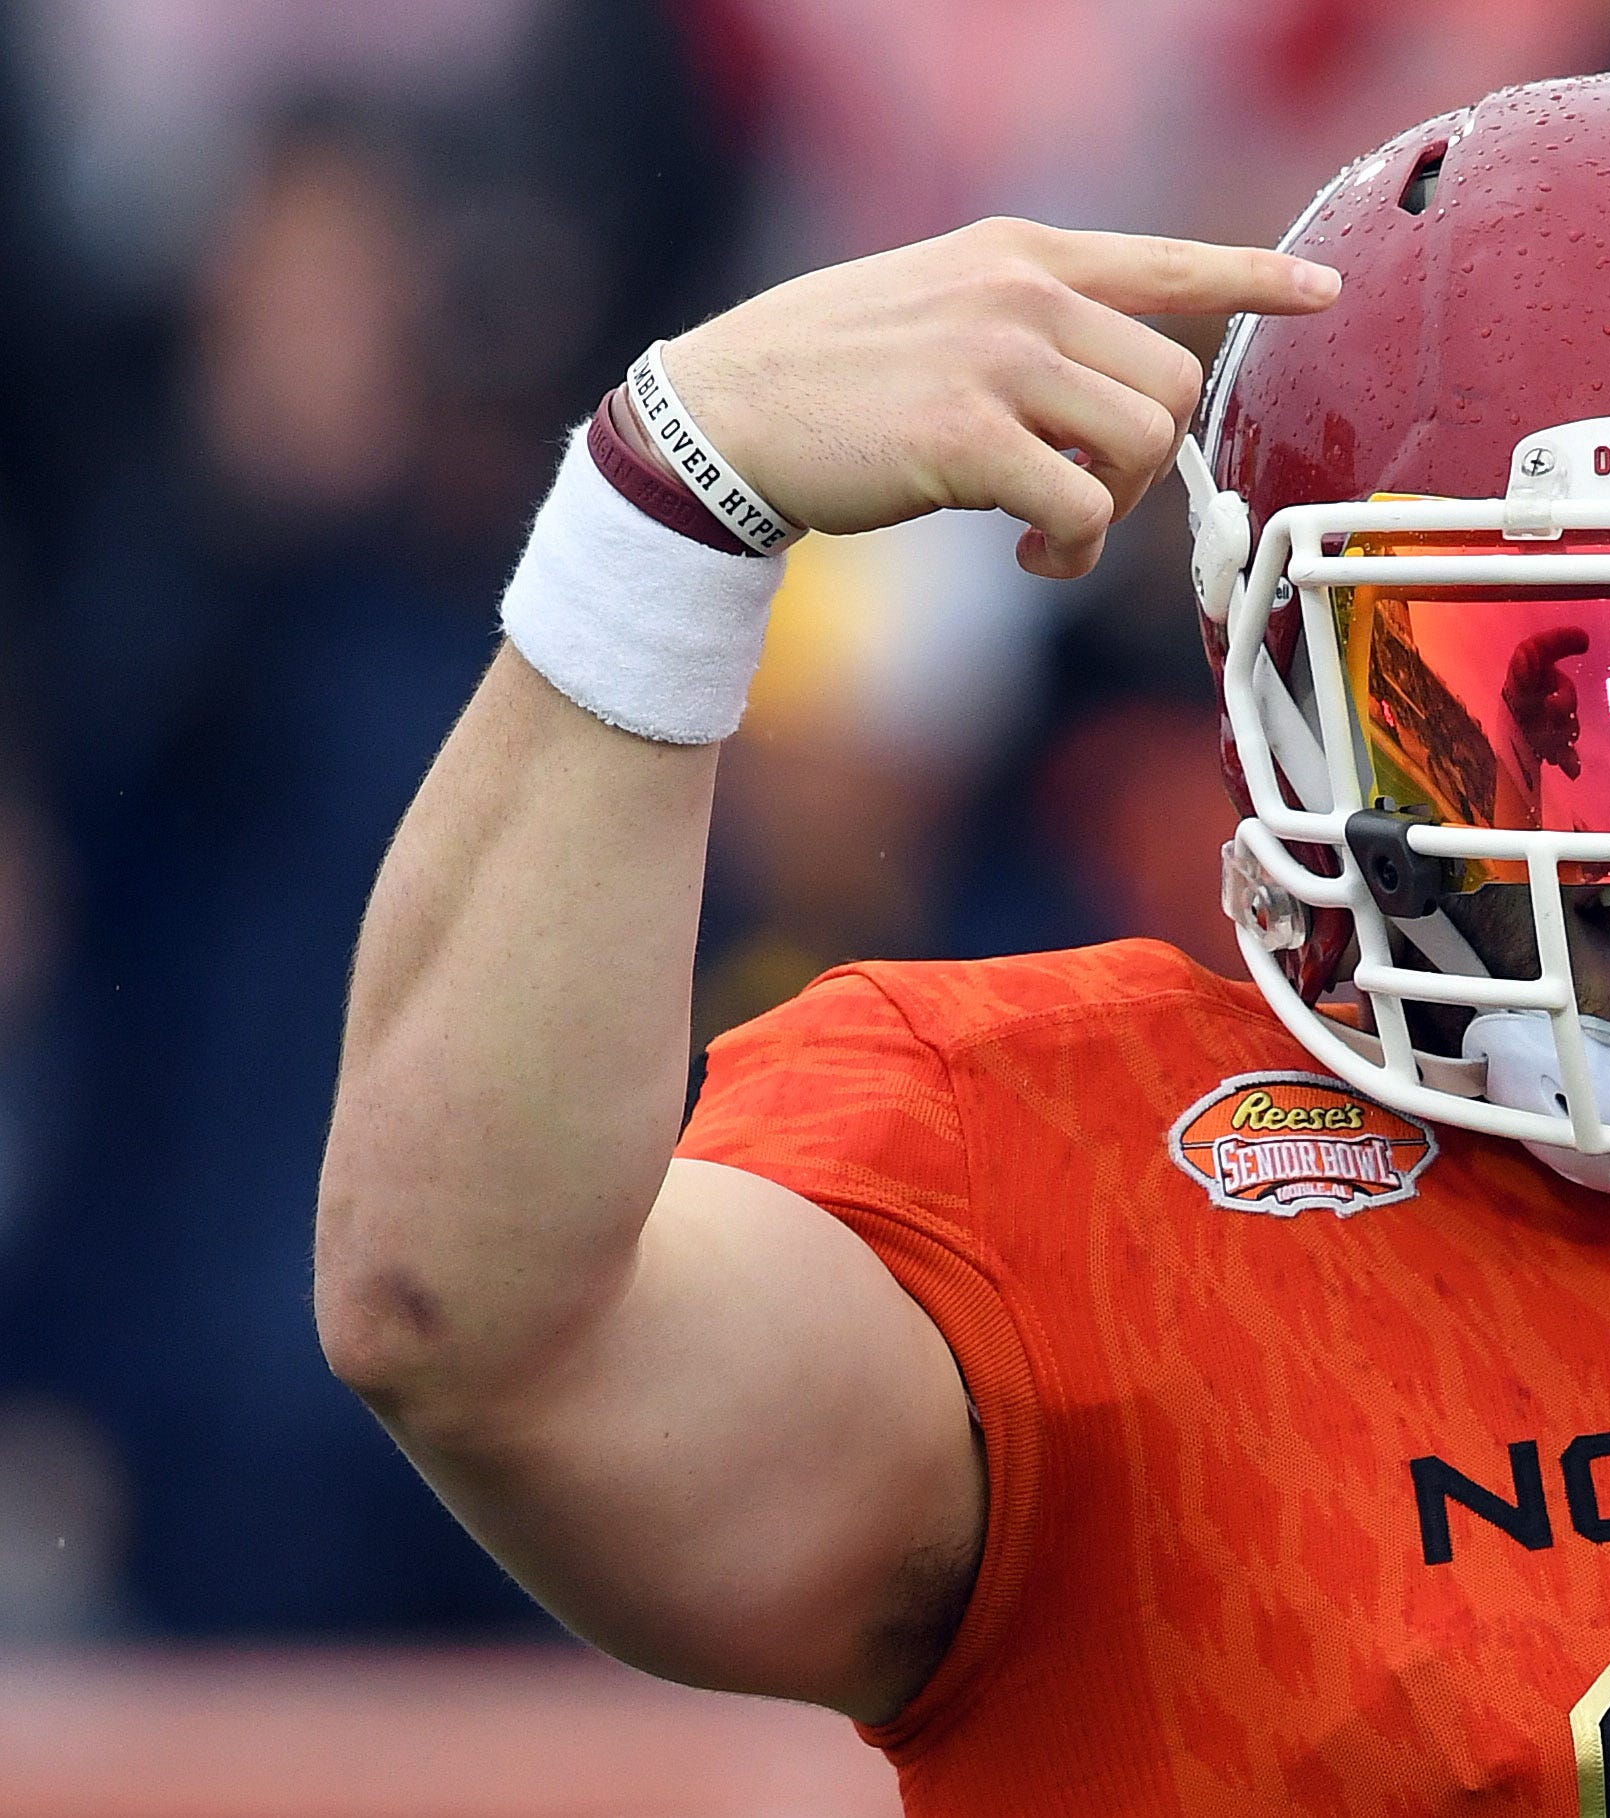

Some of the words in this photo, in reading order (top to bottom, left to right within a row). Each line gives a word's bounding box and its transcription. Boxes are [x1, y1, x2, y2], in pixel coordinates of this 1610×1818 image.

[632, 353, 669, 421] UMBLE
[660, 418, 721, 491] OVER
[719, 488, 785, 549] HYPE
[1231, 1090, 1364, 1131] Reese's
[1219, 1140, 1321, 1193] SENIOR
[1318, 1140, 1401, 1188] BOWL
